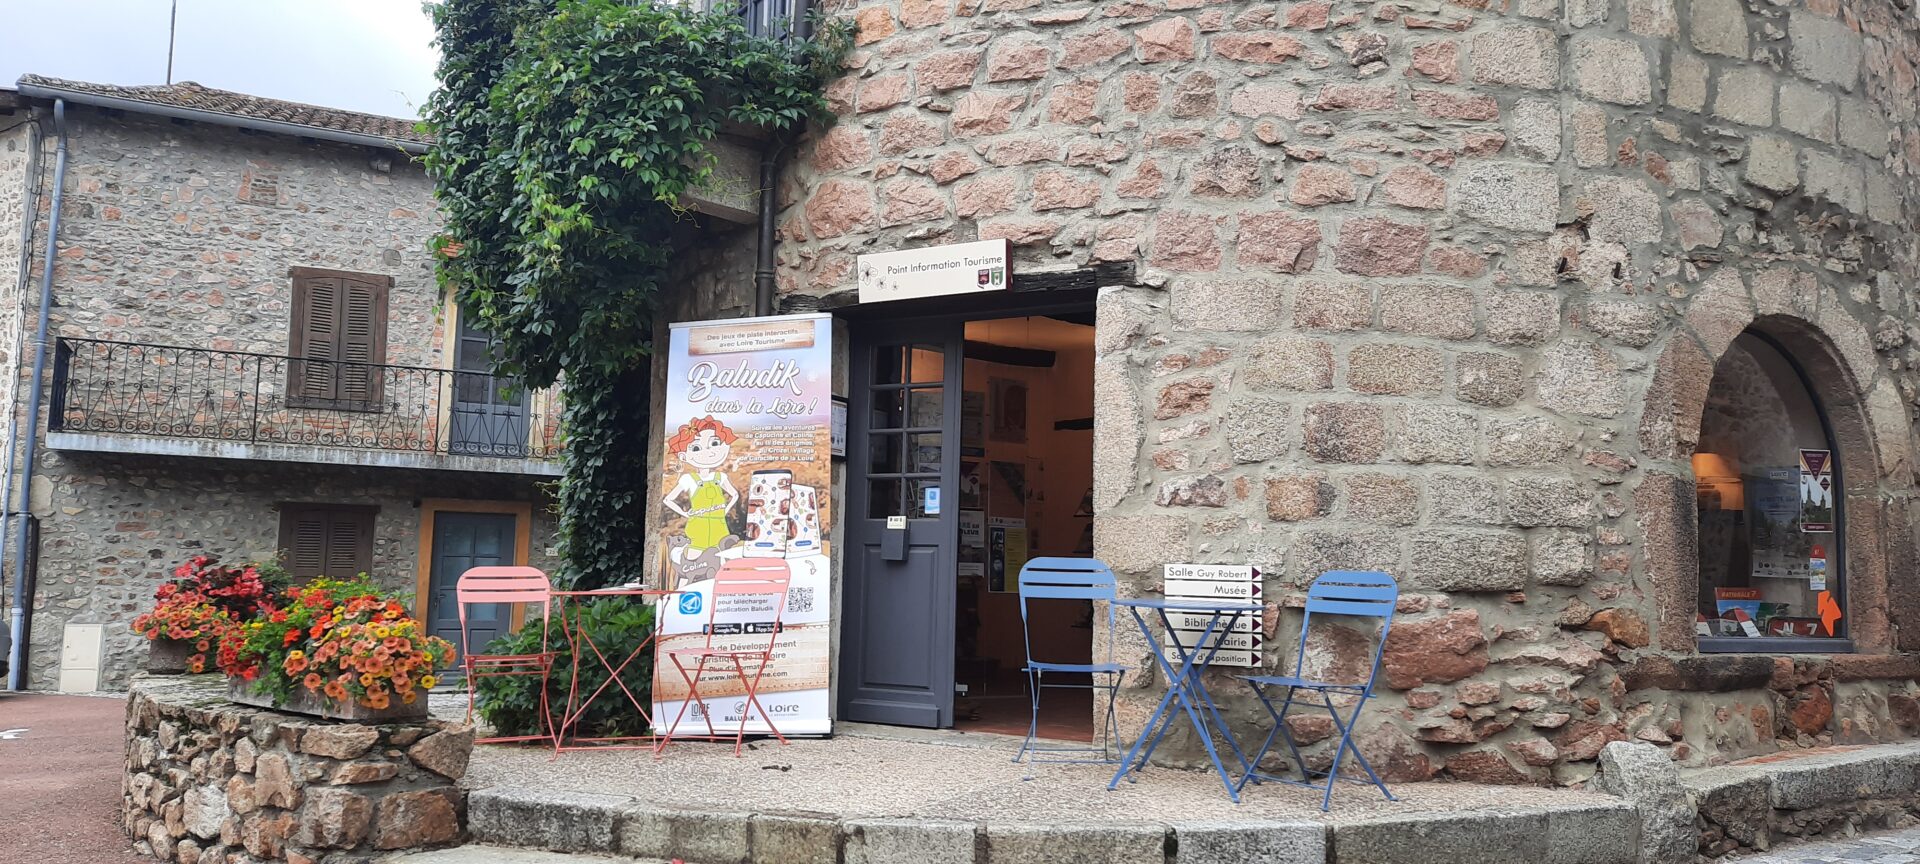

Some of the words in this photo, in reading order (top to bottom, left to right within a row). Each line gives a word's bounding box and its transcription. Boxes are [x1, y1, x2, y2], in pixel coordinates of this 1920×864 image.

[888, 265, 908, 275] Point
[911, 260, 961, 273] Information
[963, 256, 1002, 266] Tourisme
[721, 333, 735, 341] jeux
[764, 328, 799, 337] interactifs
[736, 339, 754, 347] Loire
[755, 337, 786, 345] Tourisme
[687, 358, 802, 402] Baludik
[705, 396, 742, 414] dans
[745, 397, 764, 414] la
[766, 397, 807, 419] Loire
[807, 397, 819, 415] !
[682, 561, 708, 572] Coline
[1168, 567, 1193, 577] Salle
[1197, 569, 1215, 579] Guy
[1218, 570, 1247, 578] Robert
[1214, 585, 1247, 595] Musée
[1783, 622, 1794, 634] N
[1806, 623, 1817, 635] 7
[730, 640, 797, 651] Développment
